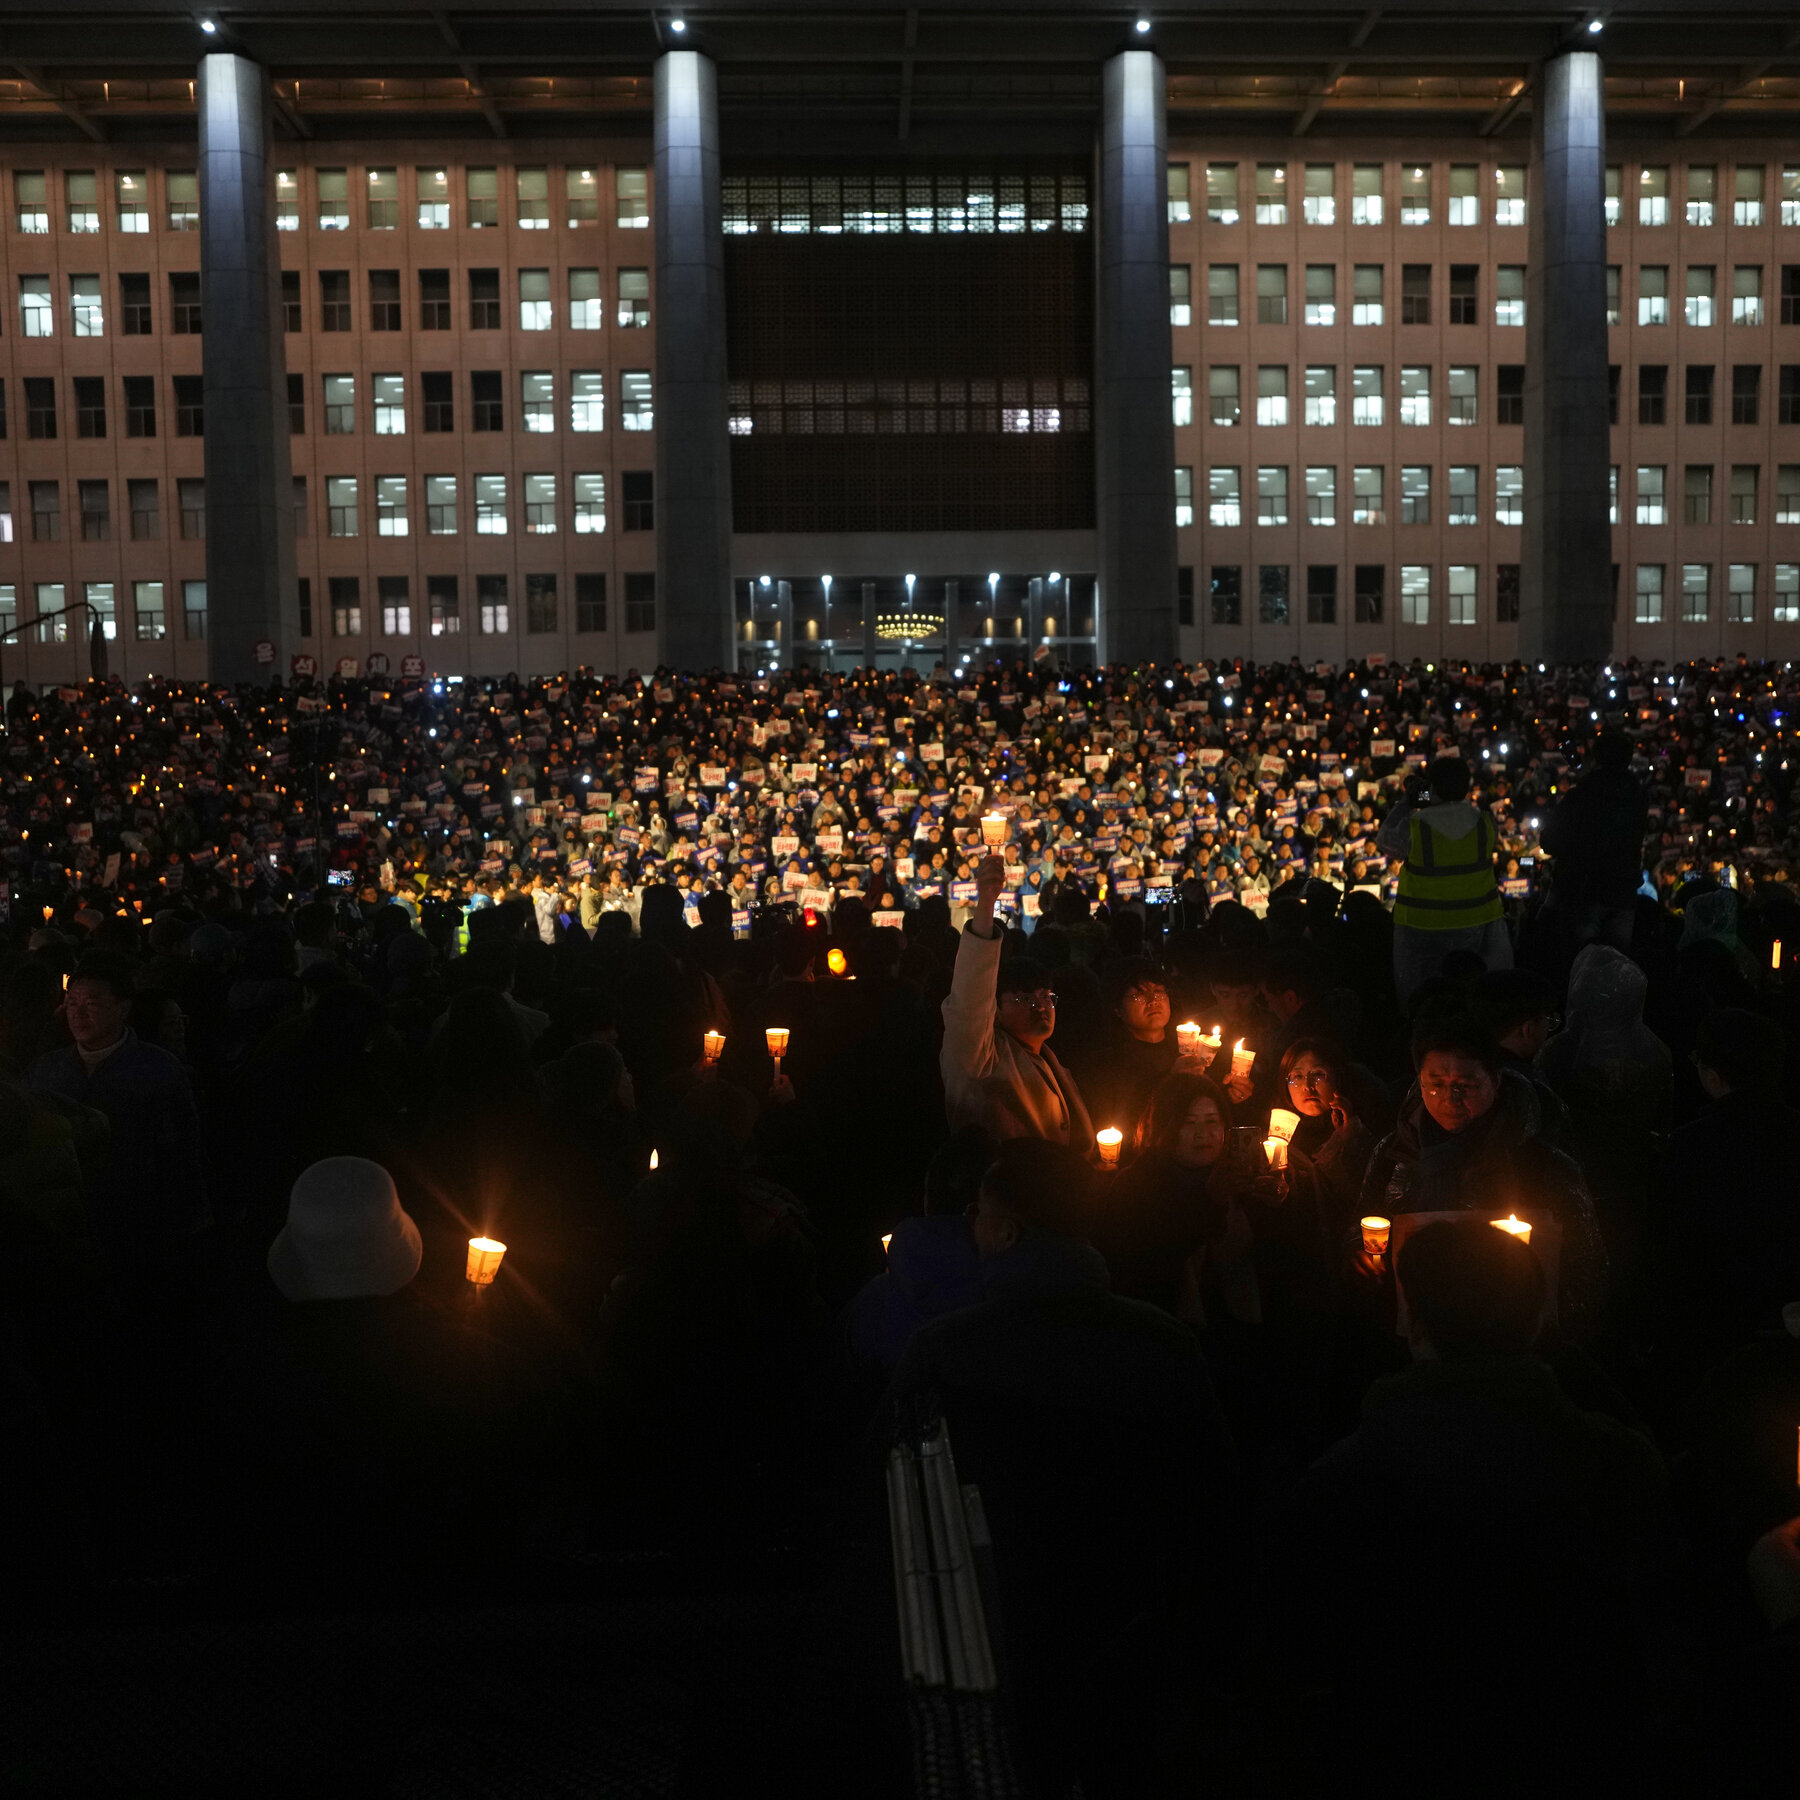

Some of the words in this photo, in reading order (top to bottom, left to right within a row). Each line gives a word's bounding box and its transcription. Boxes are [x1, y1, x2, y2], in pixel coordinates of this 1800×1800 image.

[296, 659, 313, 675] 석
[341, 660, 358, 678] 열
[371, 656, 387, 674] 체
[405, 658, 422, 675] 포
[804, 896, 826, 906] 탄핵!
